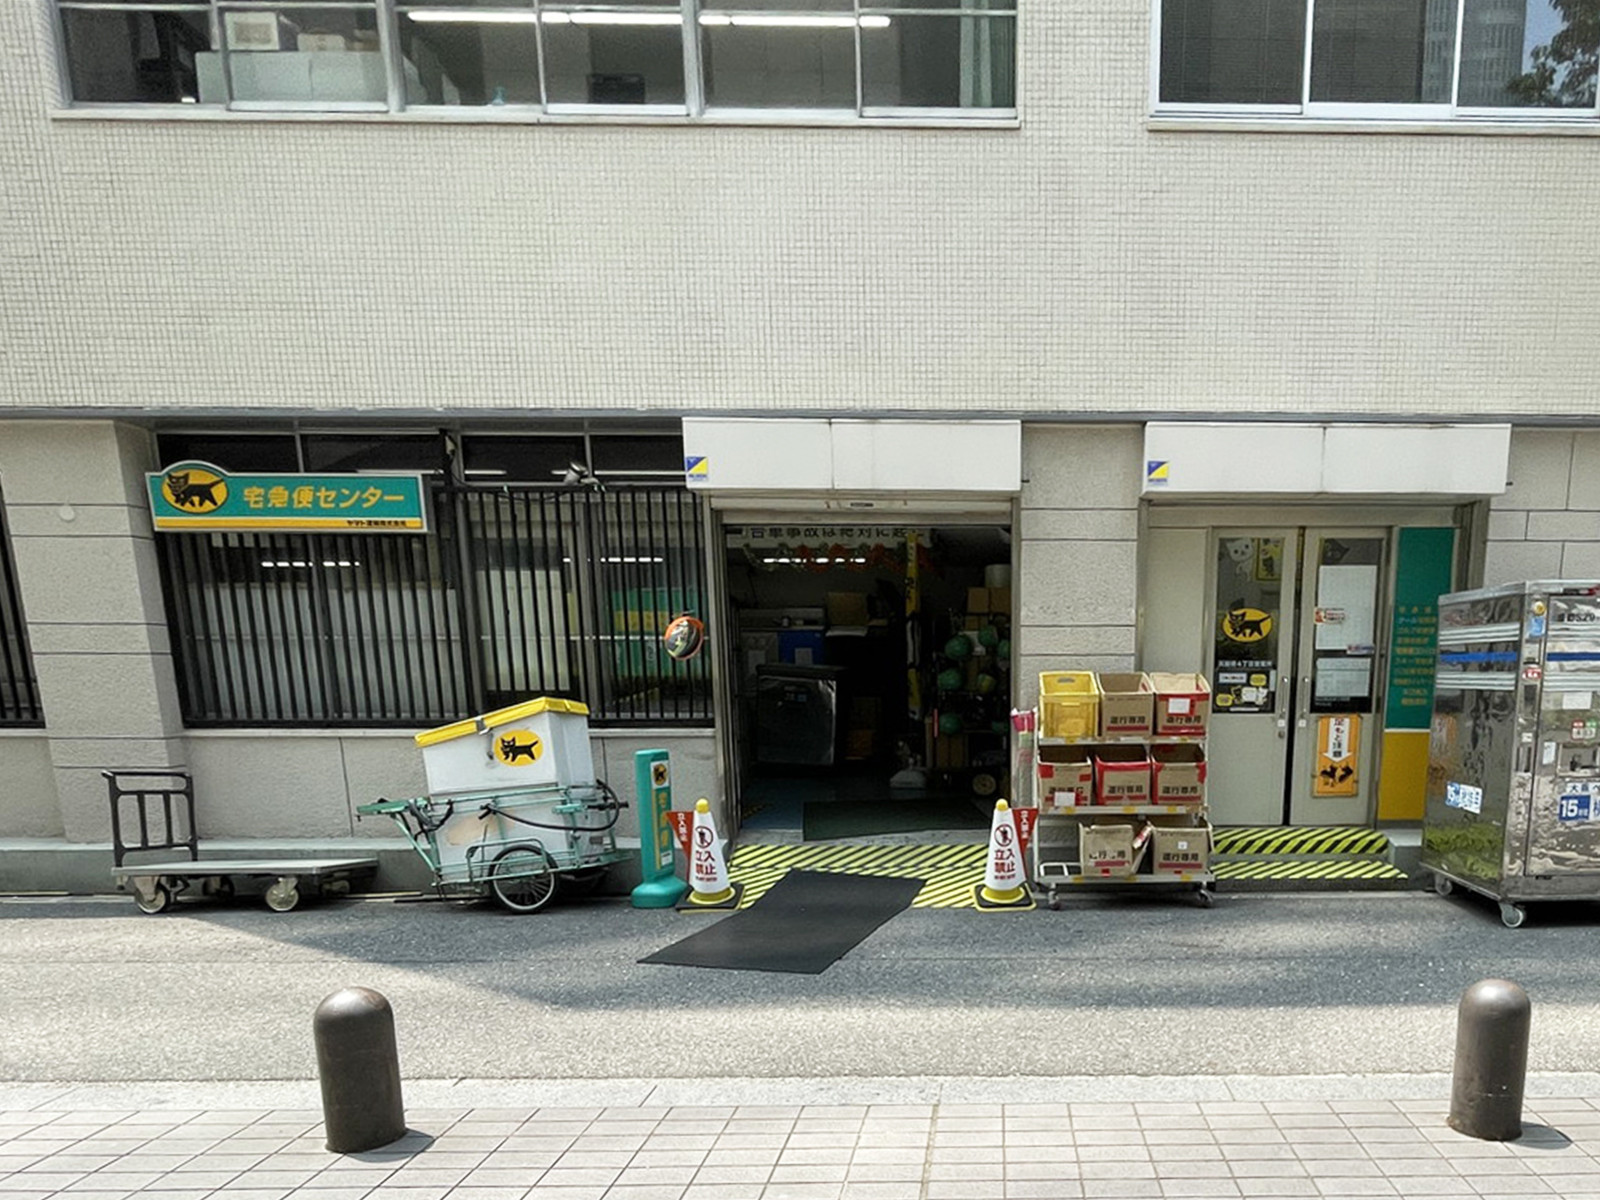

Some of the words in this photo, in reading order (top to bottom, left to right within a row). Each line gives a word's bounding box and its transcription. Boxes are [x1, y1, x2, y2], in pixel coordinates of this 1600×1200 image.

[243, 486, 405, 509] 宅急便センター
[1561, 799, 1579, 818] 15
[695, 850, 716, 862] 立入
[994, 848, 1016, 861] 立入
[695, 863, 717, 876] 禁止
[994, 861, 1016, 873] 禁止
